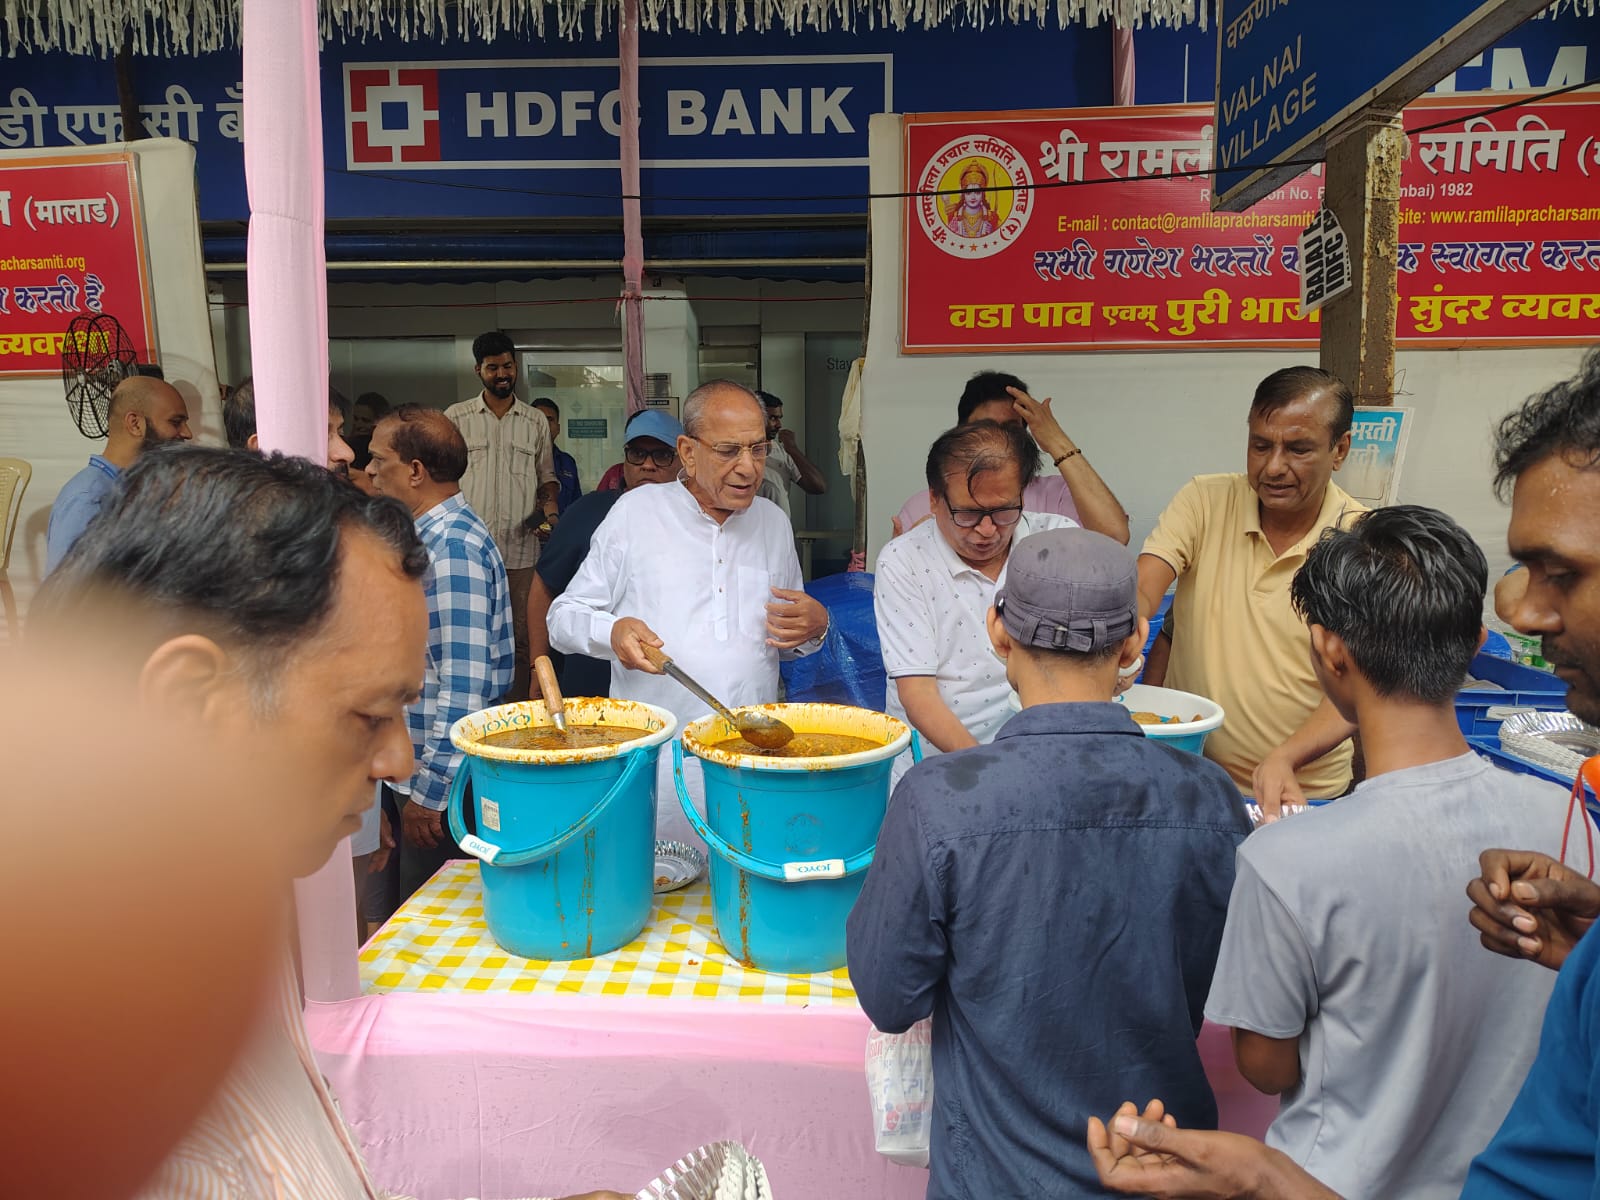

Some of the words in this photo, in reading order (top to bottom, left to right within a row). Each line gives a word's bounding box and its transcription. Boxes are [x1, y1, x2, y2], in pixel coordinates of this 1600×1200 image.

[1223, 33, 1302, 127] VALNAI
[465, 90, 642, 138] HDFC
[667, 86, 856, 137] BANK
[1221, 72, 1317, 168] VILLAGE
[1038, 129, 1089, 183] श्री
[1419, 114, 1566, 174] समिति
[24, 191, 120, 231] (मालाड)
[1290, 187, 1312, 200] No.
[1399, 183, 1435, 200] mbai)
[1439, 182, 1473, 197] 1982
[1058, 215, 1099, 232] E-mail
[1112, 210, 1315, 233] contact@ramlilapracharsamiti
[1398, 208, 1426, 224] site:
[1431, 205, 1600, 227] www.ramlilapracharsam
[0, 254, 86, 272] acharsamiti.org
[1033, 237, 1097, 281] सभी
[1103, 236, 1184, 279] गणेश
[1190, 233, 1275, 278] भक्तों
[1431, 241, 1535, 274] स्वागत
[1303, 234, 1325, 307] BAJAJ
[1324, 231, 1345, 295] IDFC
[14, 274, 81, 313] करती
[84, 273, 105, 313] है
[949, 303, 1014, 328] वडा
[1022, 302, 1094, 328] पाव
[1102, 305, 1160, 333] एवम्
[1167, 288, 1232, 336] पुरी
[1409, 284, 1494, 333] सुंदर
